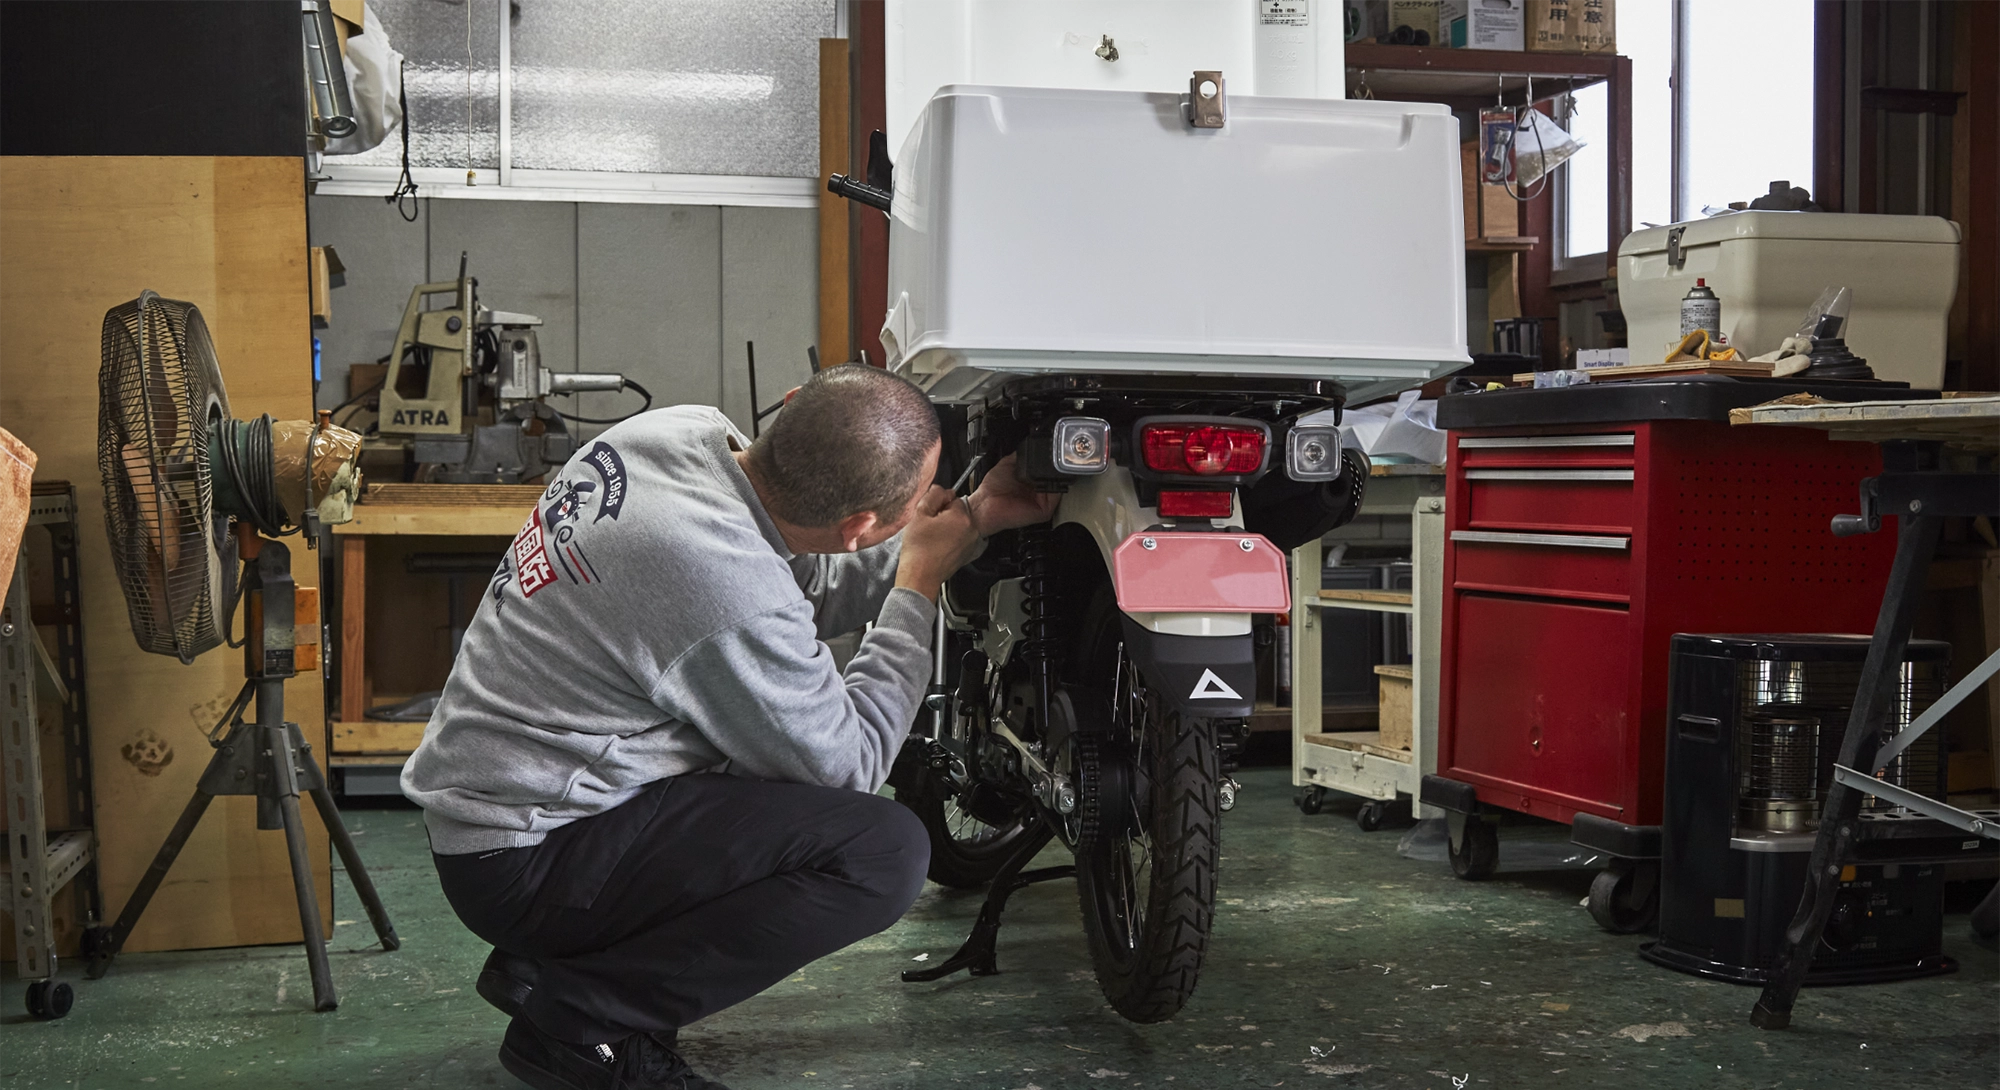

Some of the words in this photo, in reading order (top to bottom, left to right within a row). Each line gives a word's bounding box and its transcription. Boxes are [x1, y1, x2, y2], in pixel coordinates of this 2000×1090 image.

[392, 409, 449, 426] ATRA
[595, 450, 617, 477] since
[605, 475, 622, 507] 1955
